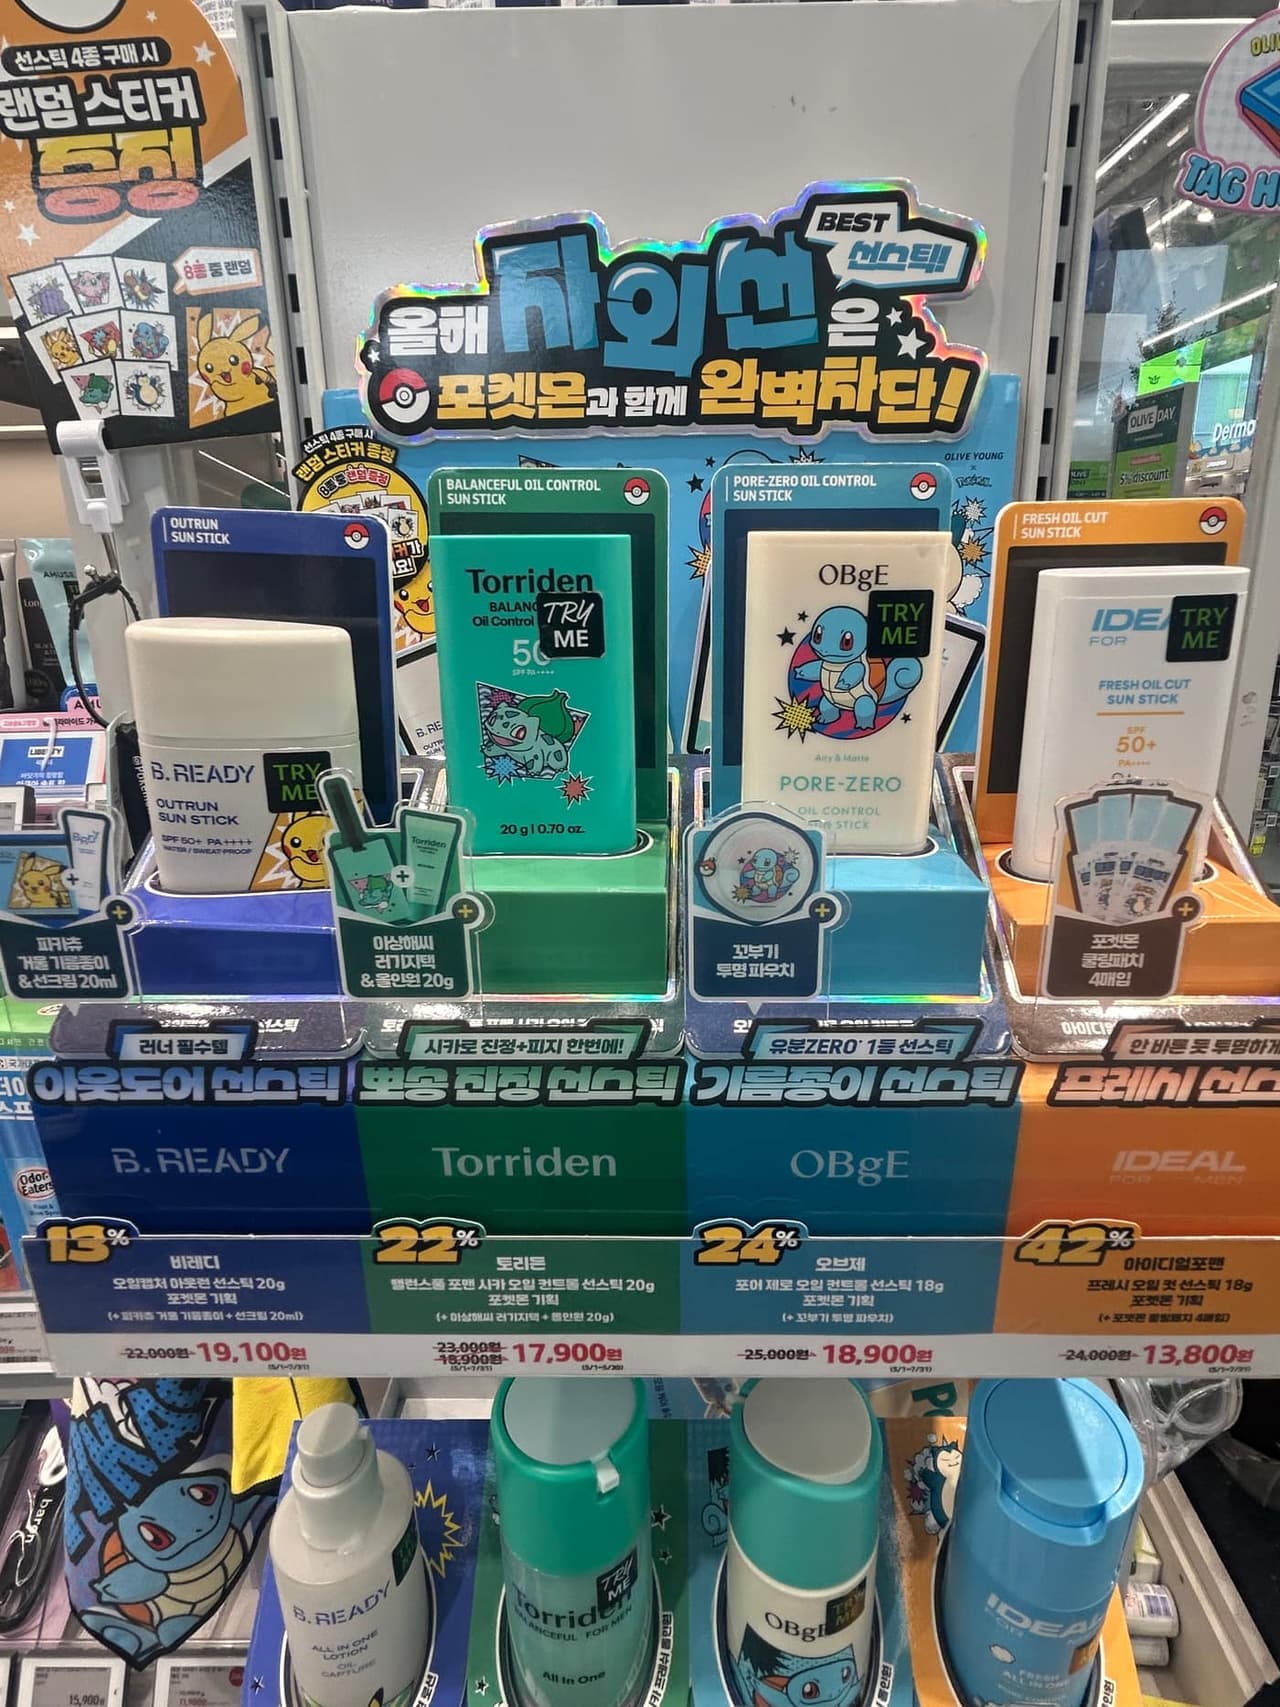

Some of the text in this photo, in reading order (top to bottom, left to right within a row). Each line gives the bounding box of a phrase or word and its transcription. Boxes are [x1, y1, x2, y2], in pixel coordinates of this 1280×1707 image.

[14, 41, 160, 72] 선스틱 4종 구매 시
[0, 76, 200, 132] 랜덤 스티커
[36, 126, 200, 217] 증정
[1183, 154, 1247, 205] TAG
[816, 211, 891, 233] BEST
[224, 259, 252, 276] 랜덤
[387, 304, 489, 357] 올해
[436, 356, 974, 425] 포켓몬과 함께 완벽차단!
[1130, 406, 1177, 429] OLIVE DAY
[295, 441, 396, 482] 랜덤 스티커 증정
[944, 451, 1004, 461] OLIVE YOUNG
[446, 478, 601, 492] BALANCEFUL OIL CONTROL
[733, 475, 877, 488] PORE-ZERO OIL CONTROL
[1132, 468, 1170, 484] discount
[447, 493, 507, 505] SUN STICK
[170, 517, 219, 532] OUTRUN
[1022, 511, 1108, 525] FRESH OIL CUT
[465, 567, 594, 595] Torriden
[818, 564, 889, 592] OBgE
[542, 600, 596, 628] TRY
[876, 603, 926, 622] TRY
[471, 616, 534, 628] Oil Control
[553, 629, 589, 648] ME
[880, 627, 919, 645] ME
[1088, 636, 1127, 647] FOR
[1115, 736, 1157, 753] 50+
[151, 761, 256, 784] B.READY
[779, 775, 903, 793] PORE-ZERO
[797, 806, 883, 817] OIL CONTROL
[500, 824, 586, 837] 20 g 0.70 oz.
[835, 820, 870, 830] STICK
[161, 834, 180, 845] SPF
[181, 835, 202, 846] 50+
[36, 936, 84, 952] 피카츄
[372, 935, 434, 951] 이상해씨
[1090, 933, 1140, 950] 포켓몬
[732, 943, 780, 961] 꼬부기
[1080, 952, 1145, 969] 쿨링패치
[17, 955, 110, 971] 거울 기름종이
[374, 954, 436, 970] 러기지택
[716, 962, 796, 979] 투명 파우치
[1088, 971, 1133, 988] 4매입
[139, 1038, 230, 1056] 러너 필수템
[424, 1038, 625, 1056] 시카로 진정+피지 한번에!
[867, 1038, 896, 1056] 1등
[898, 1038, 954, 1056] 선스틱
[1128, 1038, 1152, 1056] 안
[1152, 1038, 1188, 1056] 바른
[1211, 1038, 1280, 1056] 투명하게
[33, 1065, 206, 1102] 아웃도어
[211, 1065, 341, 1102] 선스틱
[454, 1065, 543, 1103] 진정
[548, 1065, 681, 1102] 선스틱
[696, 1065, 1018, 1103] 기름종이 선스틱
[1054, 1066, 1201, 1103] 프레시
[790, 1149, 910, 1187] OBgE
[1111, 1149, 1247, 1173] IDEAL
[1109, 1175, 1244, 1185] FOR MEN
[46, 1225, 130, 1263] 13%
[376, 1226, 479, 1264] 22%
[698, 1226, 799, 1264] 24%
[1018, 1226, 1132, 1264] 42%
[170, 1255, 221, 1270] 비레디
[496, 1256, 547, 1272] 토리든
[815, 1257, 867, 1273] 오브제
[1123, 1256, 1226, 1273] 아이디얼포맨
[112, 1277, 286, 1292] 오일캡처 아웃런 선스틱 20g
[390, 1278, 656, 1294] 밸런스풀 포맨 시카 오일 컨트롤 선스틱 20g
[735, 1279, 945, 1294] 포어 제로 오일 컨트롤 선스틱 18g
[1087, 1279, 1254, 1293] 프레시 오일 컷 선스틱 18g
[167, 1292, 238, 1306] 포켓몬 기획
[196, 1341, 307, 1364] 19,100원
[512, 1342, 623, 1364] 17,900원
[822, 1343, 933, 1366] 18,900원
[1143, 1343, 1254, 1366] 13,800원
[514, 1605, 633, 1642] BALANCEFUL FOR MEN
[323, 1643, 369, 1661] LOTION
[542, 1670, 607, 1686] All In One
